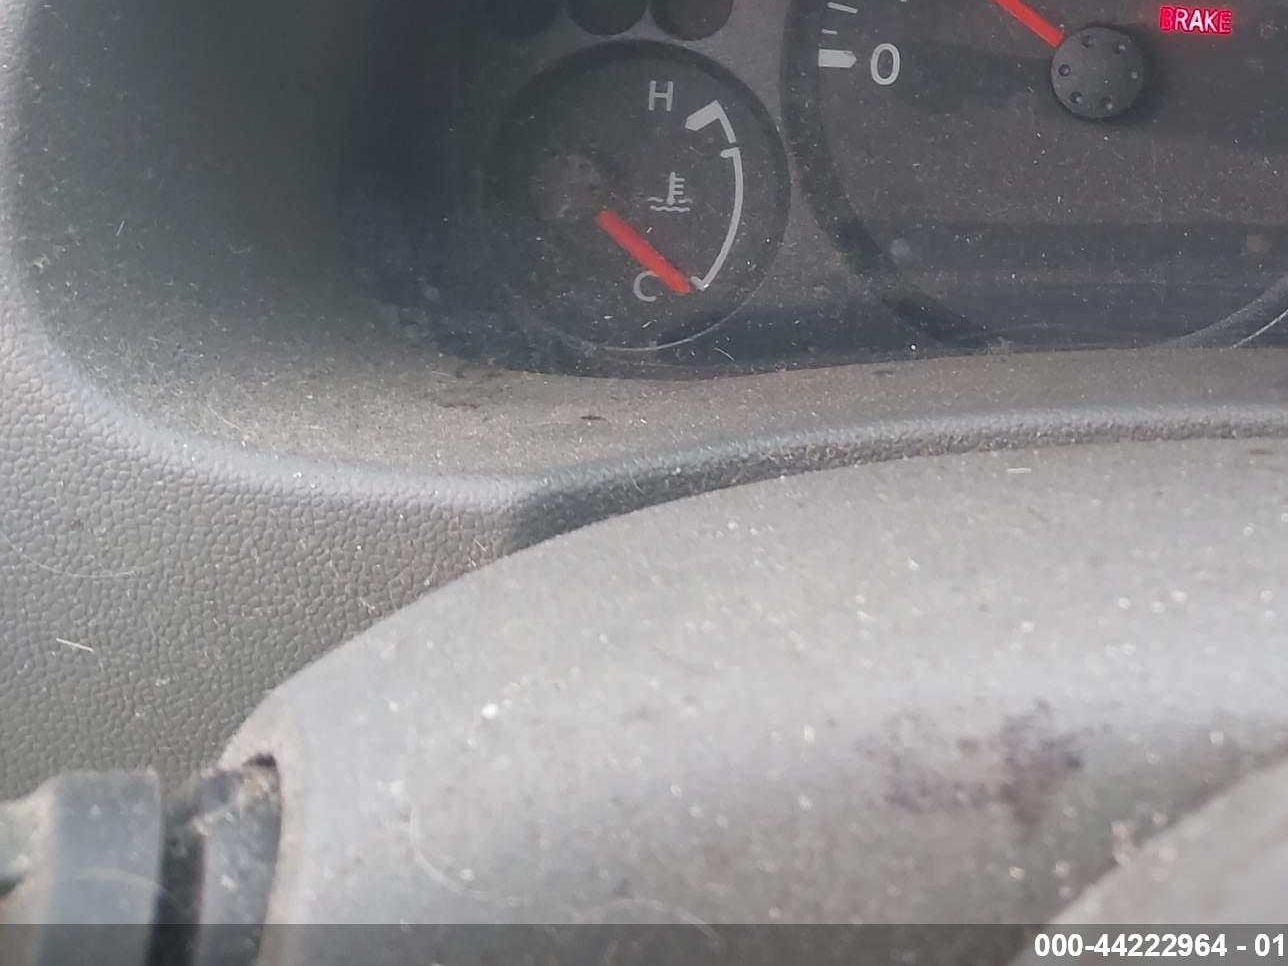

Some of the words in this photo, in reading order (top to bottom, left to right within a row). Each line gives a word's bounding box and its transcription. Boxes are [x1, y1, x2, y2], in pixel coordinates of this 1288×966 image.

[1160, 6, 1232, 34] BRAKE
[870, 43, 901, 86] 0
[648, 80, 674, 113] H
[633, 270, 659, 302] C
